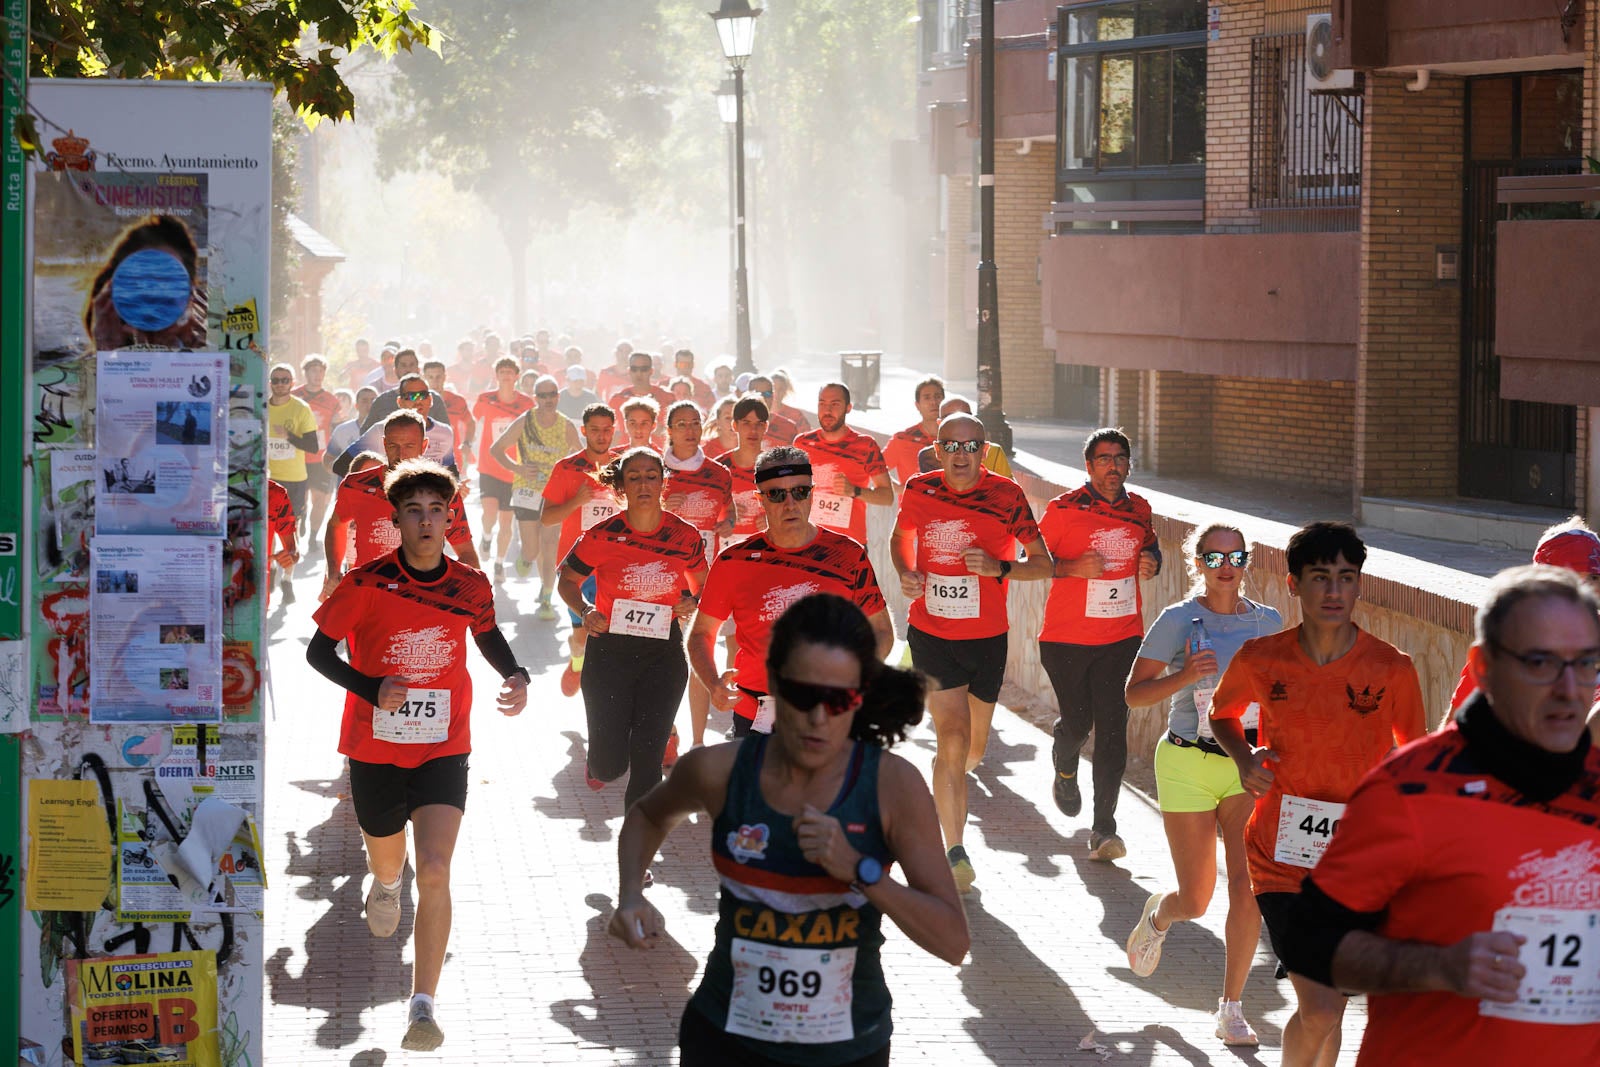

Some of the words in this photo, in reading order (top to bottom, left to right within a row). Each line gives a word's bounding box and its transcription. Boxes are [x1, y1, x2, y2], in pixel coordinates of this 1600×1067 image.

[8, 49, 21, 67] la
[8, 78, 21, 97] de
[106, 152, 157, 168] Excmo.
[160, 152, 258, 170] Ayuntamiento
[7, 172, 20, 211] Ruta
[115, 206, 150, 217] Espejos
[152, 206, 165, 216] de
[166, 206, 193, 216] Amor
[241, 313, 255, 322] NO
[592, 506, 614, 517] 579
[819, 499, 840, 512] 942
[924, 530, 973, 542] carrera
[1090, 540, 1136, 550] carrera
[623, 573, 675, 585] carrera
[932, 583, 969, 599] 1632
[1109, 588, 1118, 600] 2
[624, 609, 656, 625] 477
[390, 642, 452, 656] carrera
[390, 656, 452, 668] cruzroja.es
[389, 700, 437, 718] 475
[159, 766, 194, 778] OFERTA
[40, 797, 74, 807] Learning
[120, 912, 180, 920] Mejoramos
[733, 905, 861, 945] CAXAR
[1539, 933, 1582, 968] 12
[113, 960, 193, 973] AUTOESCUELAS
[757, 965, 822, 998] 969
[88, 991, 121, 999] TODOS
[123, 989, 142, 997] LOS
[145, 986, 194, 995] PERMISOS
[772, 1001, 809, 1013] MONTSE
[157, 997, 200, 1045] B
[93, 1023, 148, 1037] PERMISO
